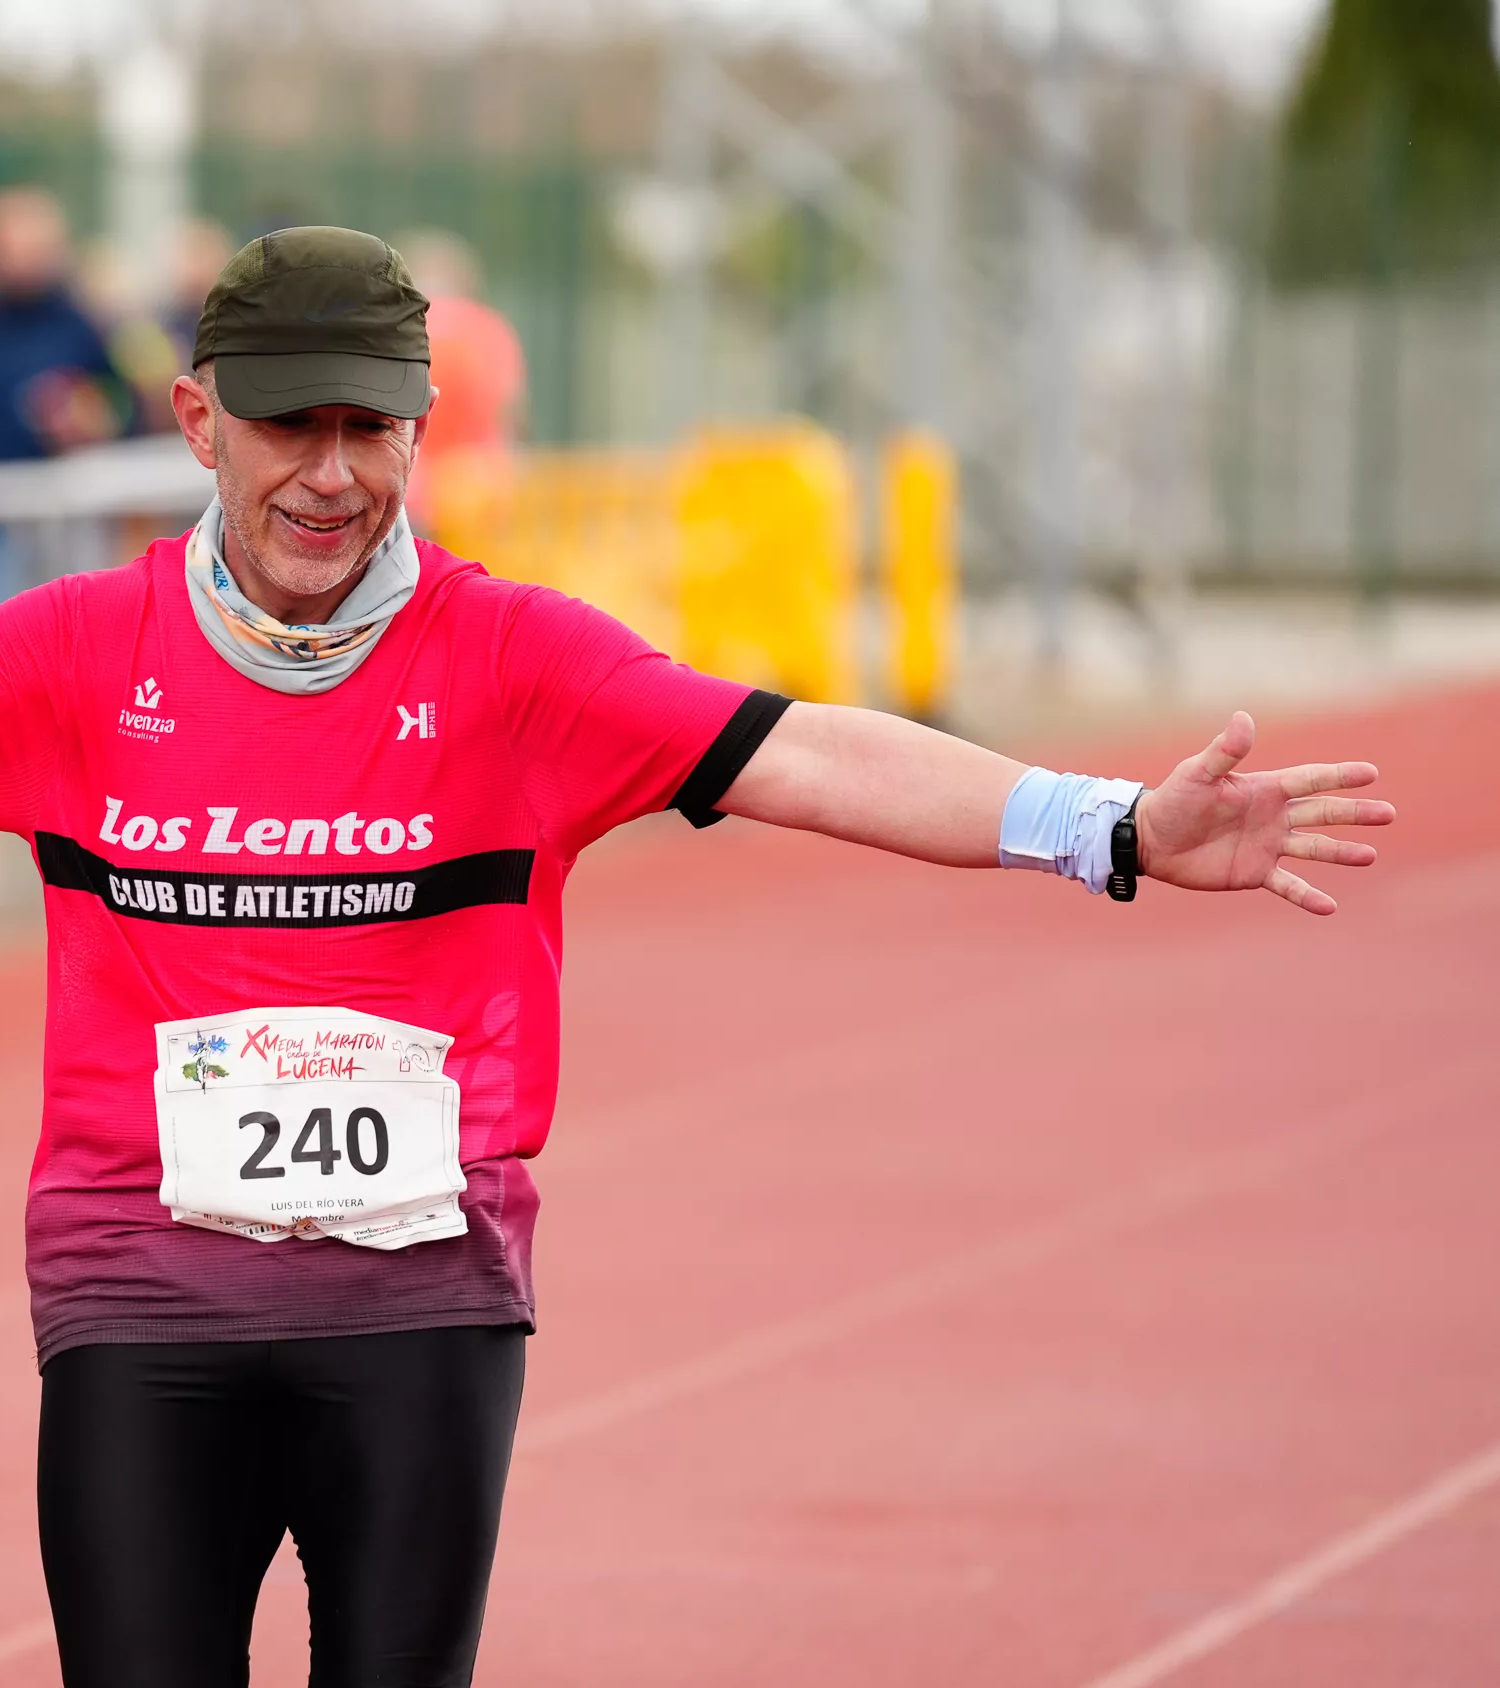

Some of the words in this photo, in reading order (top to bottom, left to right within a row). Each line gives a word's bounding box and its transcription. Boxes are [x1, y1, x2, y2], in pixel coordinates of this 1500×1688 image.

[119, 709, 176, 734] ivenzia
[100, 795, 192, 852] Los
[201, 806, 435, 856] Lentos
[108, 873, 179, 915] CLUB
[185, 884, 227, 918] DE
[233, 881, 417, 919] ATLETISMO
[240, 1024, 270, 1062] X
[276, 1055, 368, 1081] LUCENA
[239, 1107, 389, 1180] 240
[271, 1202, 293, 1211] LUIS
[295, 1200, 315, 1209] DEL
[316, 1197, 336, 1208] RÍO
[337, 1198, 365, 1208] VERA
